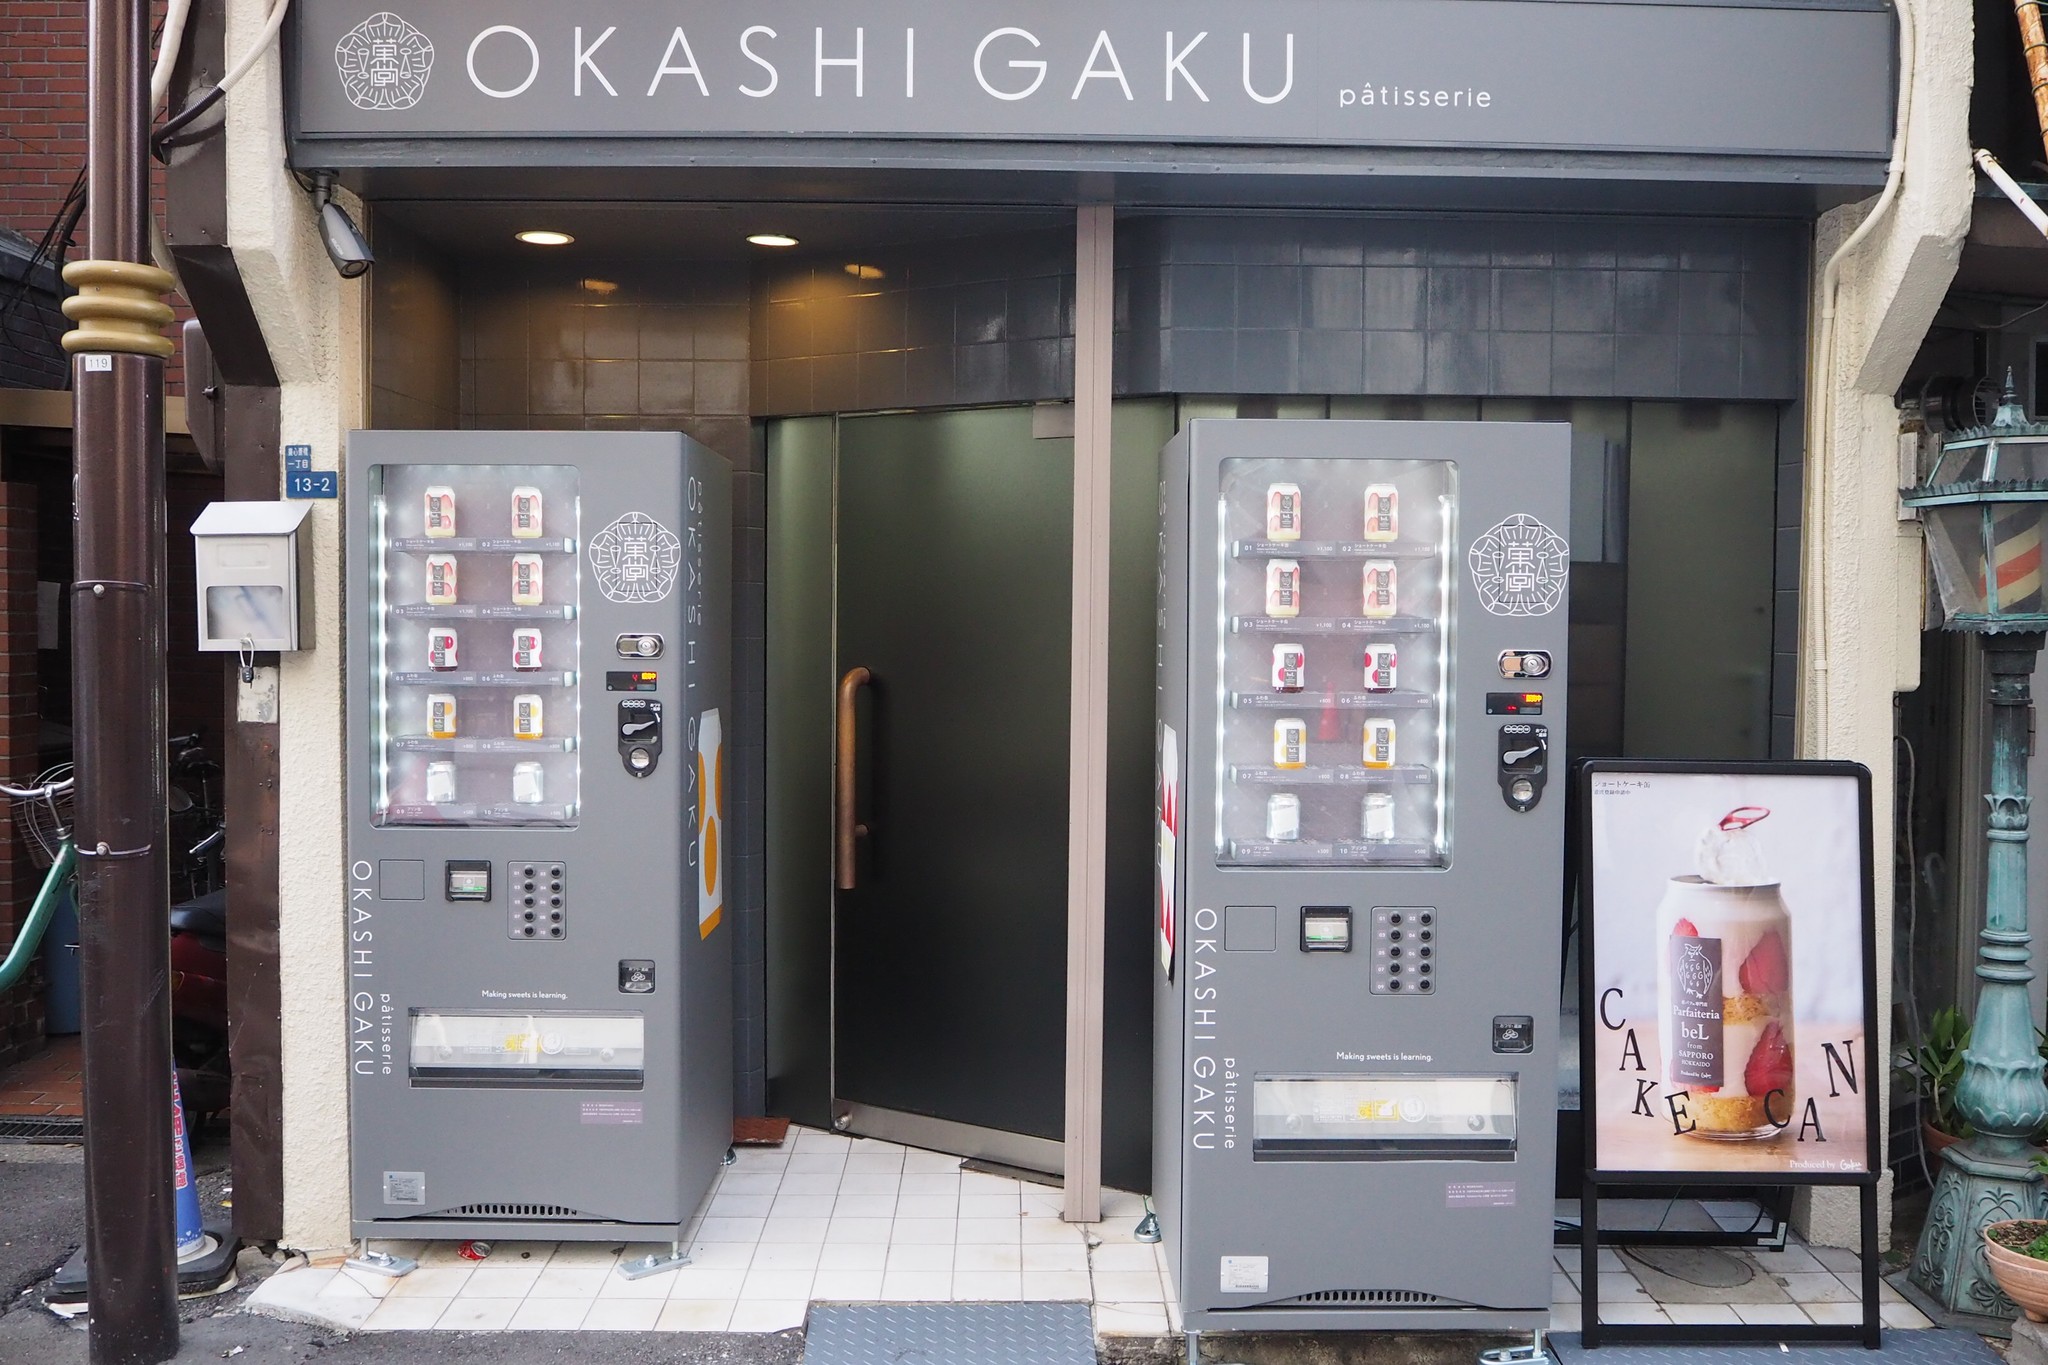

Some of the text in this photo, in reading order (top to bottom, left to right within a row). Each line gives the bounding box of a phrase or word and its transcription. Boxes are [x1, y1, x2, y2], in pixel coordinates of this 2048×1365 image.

[466, 25, 1294, 104] OKASHI GAKU
[1339, 82, 1491, 108] pâtisserie
[90, 358, 108, 368] 119
[294, 478, 330, 492] 13-2
[353, 860, 374, 1075] OKASHI GAKU
[482, 990, 507, 999] Making
[539, 991, 568, 1000] learning.
[1673, 1005, 1720, 1019] Parfaiteria
[380, 993, 394, 1075] pâtisserie
[1193, 908, 1217, 1148] OKASHI GAKU
[1682, 1022, 1709, 1040] beL
[1336, 1052, 1364, 1062] Making
[1401, 1052, 1433, 1062] learning.
[1679, 1050, 1713, 1060] SAPPORO
[1600, 988, 1858, 1142] CAKE CAN
[1224, 1058, 1239, 1148] pâtisserie
[1790, 1160, 1824, 1168] Produced
[1826, 1160, 1835, 1169] by
